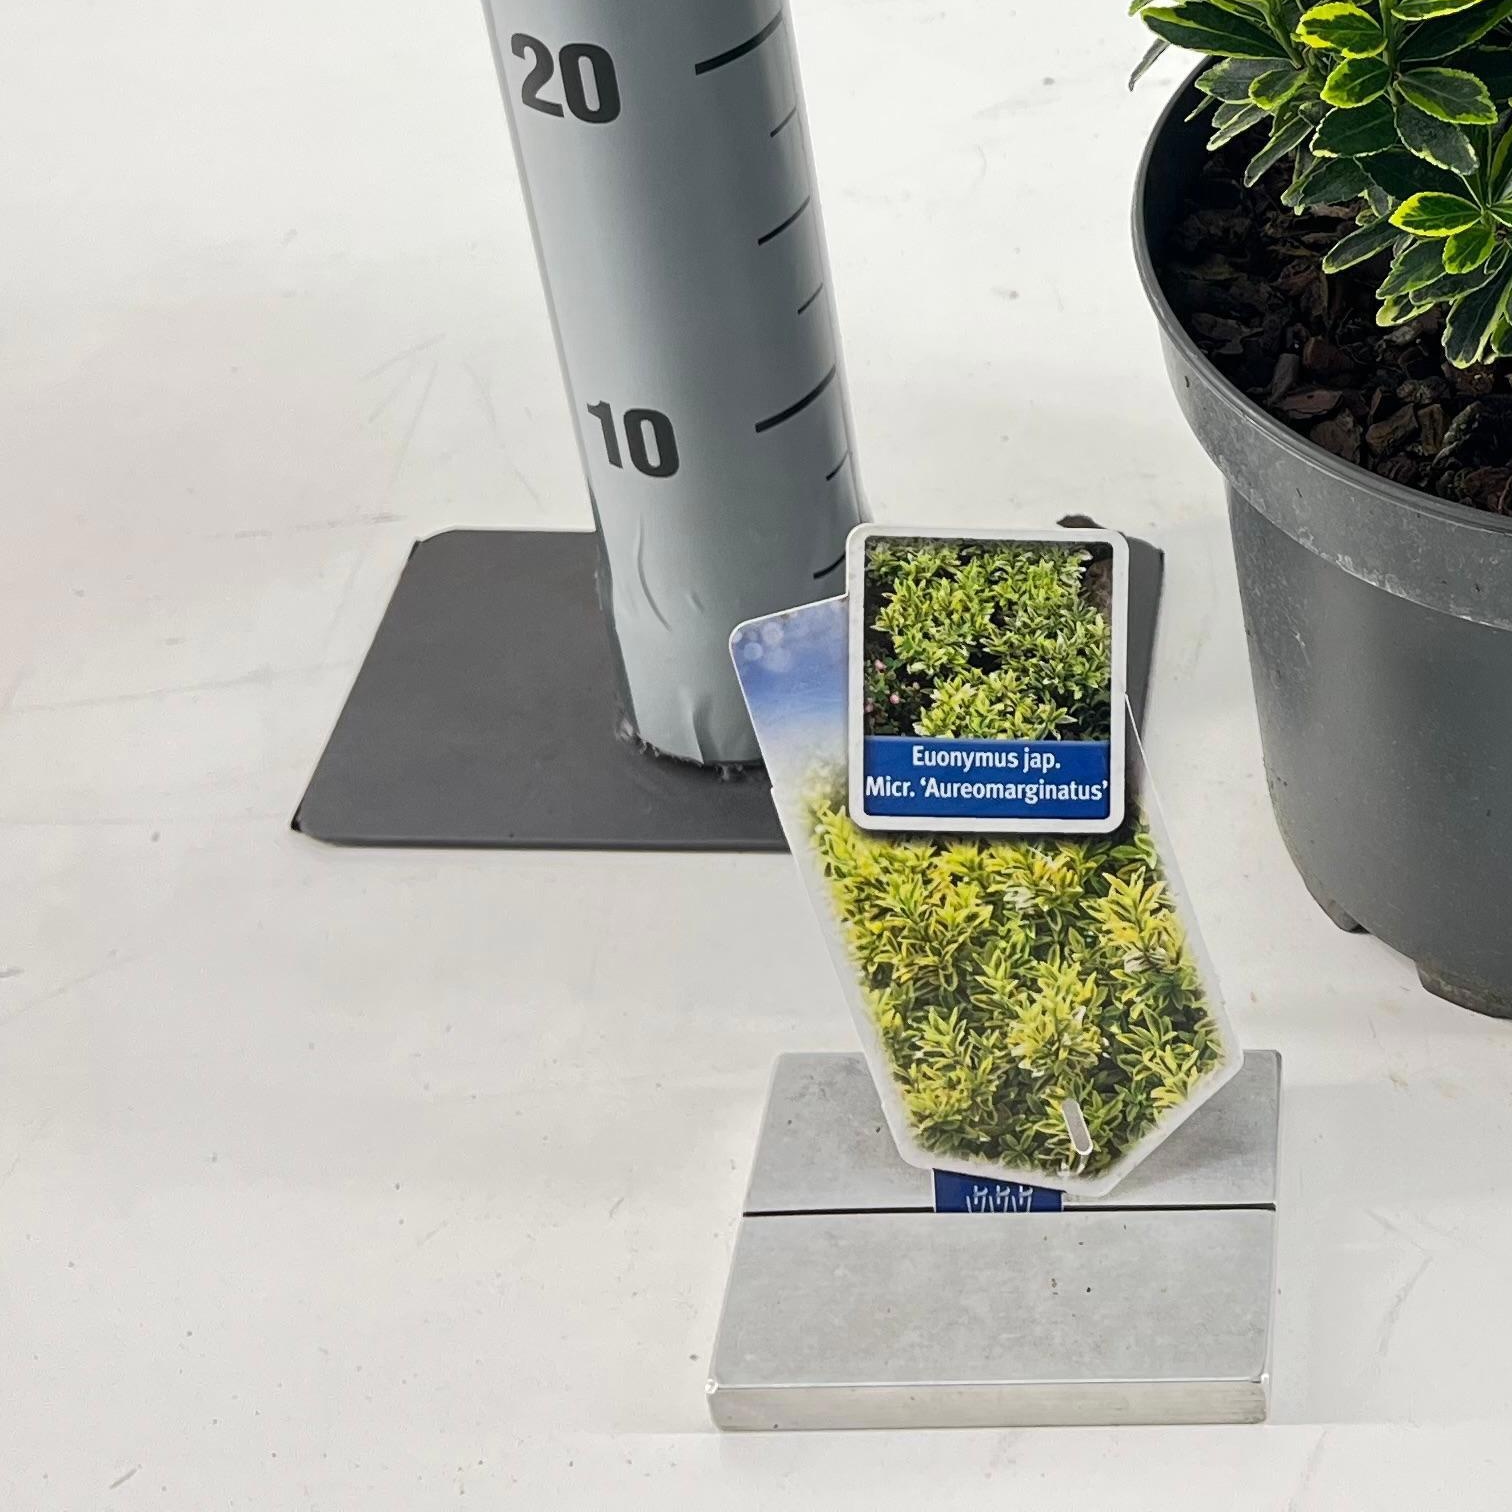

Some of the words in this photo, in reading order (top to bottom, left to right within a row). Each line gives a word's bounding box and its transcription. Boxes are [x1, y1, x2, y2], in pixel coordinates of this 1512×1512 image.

[510, 32, 621, 124] 20
[587, 400, 680, 478] 10
[912, 745, 1019, 772] Euonymus
[1022, 747, 1061, 773] jap.
[865, 776, 915, 798] Micr.
[919, 777, 1108, 805] ‘Aureomarginatus’
